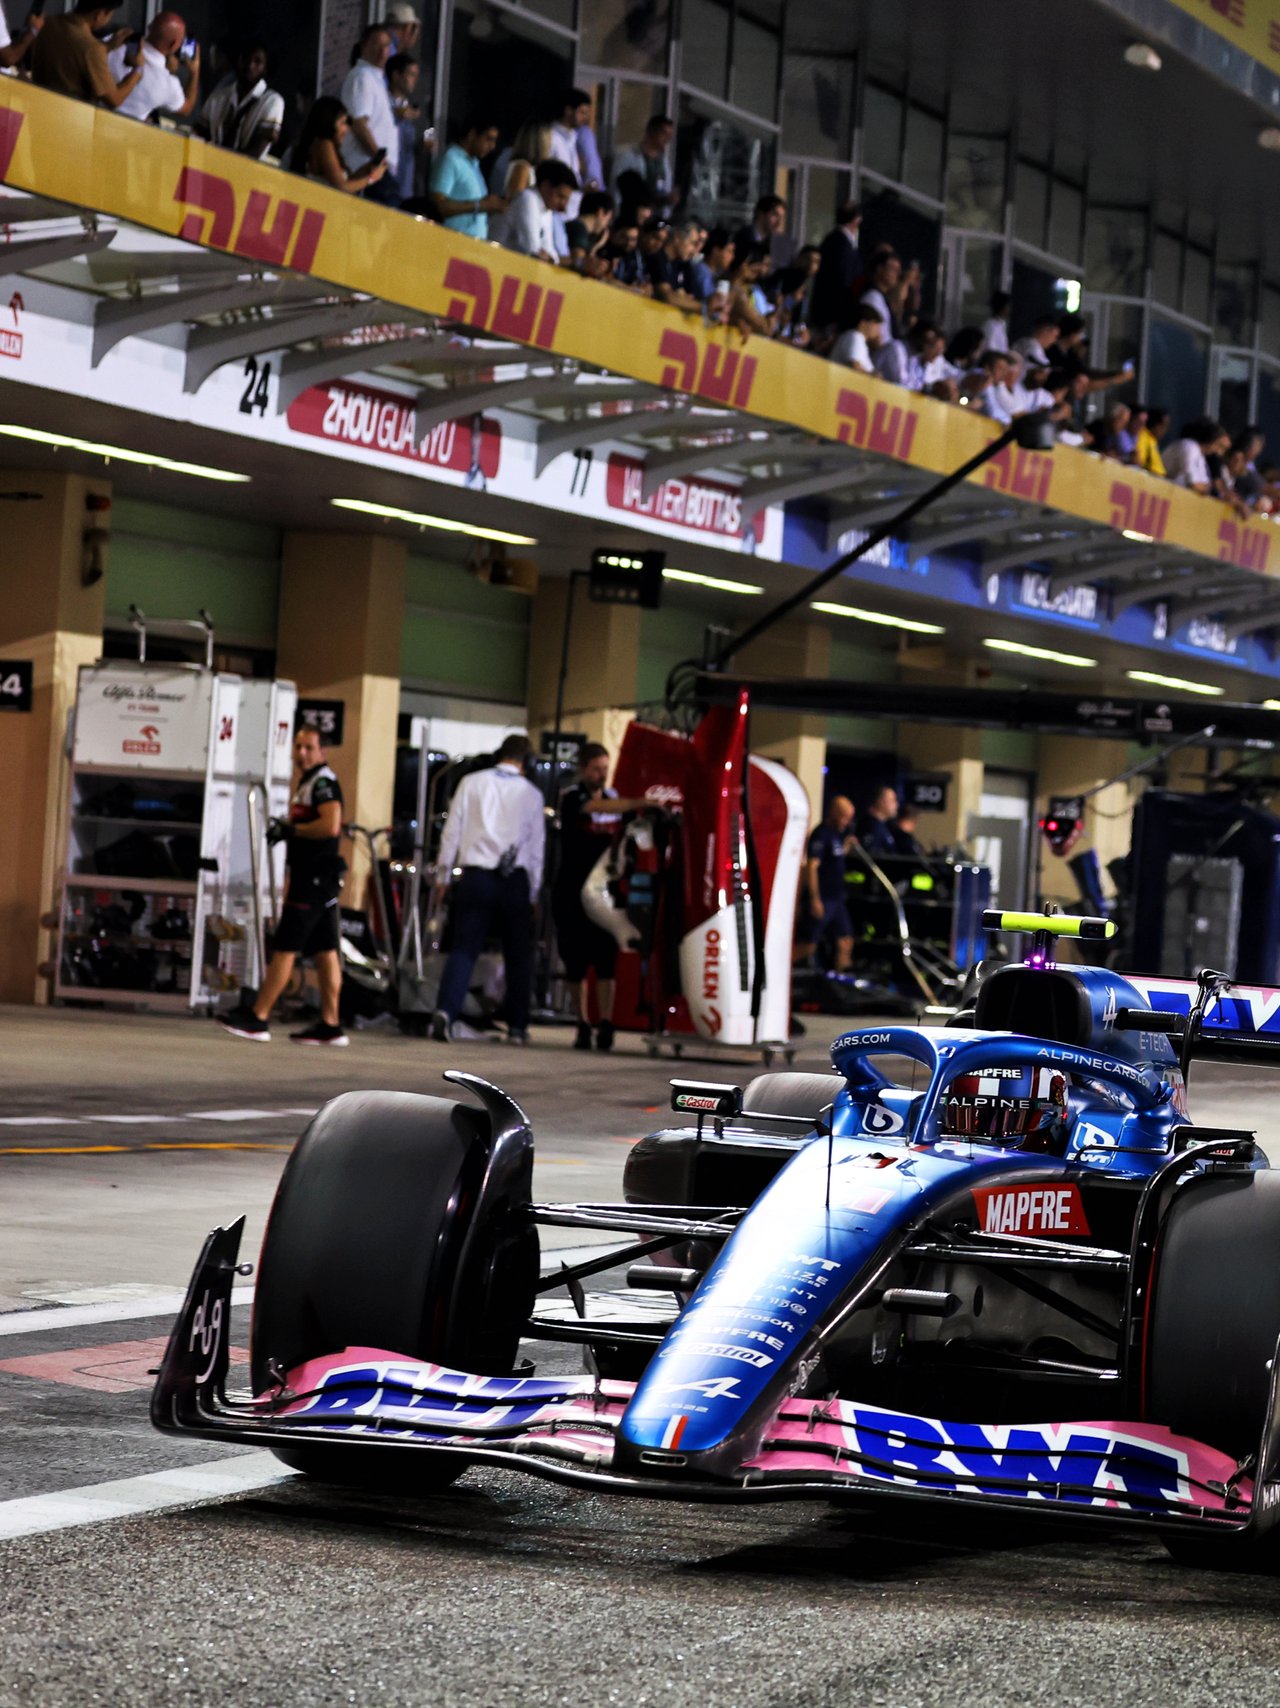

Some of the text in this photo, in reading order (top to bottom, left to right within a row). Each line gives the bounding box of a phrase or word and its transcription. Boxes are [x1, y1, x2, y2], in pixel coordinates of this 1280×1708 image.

[239, 355, 271, 417] 24
[322, 387, 456, 464] ZHOU GUAYU
[0, 673, 22, 697] 4
[703, 929, 721, 999] ORLEN
[687, 1097, 717, 1109] Castrol
[949, 1096, 1030, 1109] ALPINE
[985, 1190, 1072, 1234] MAPFRE
[853, 1408, 1180, 1514] BWT
